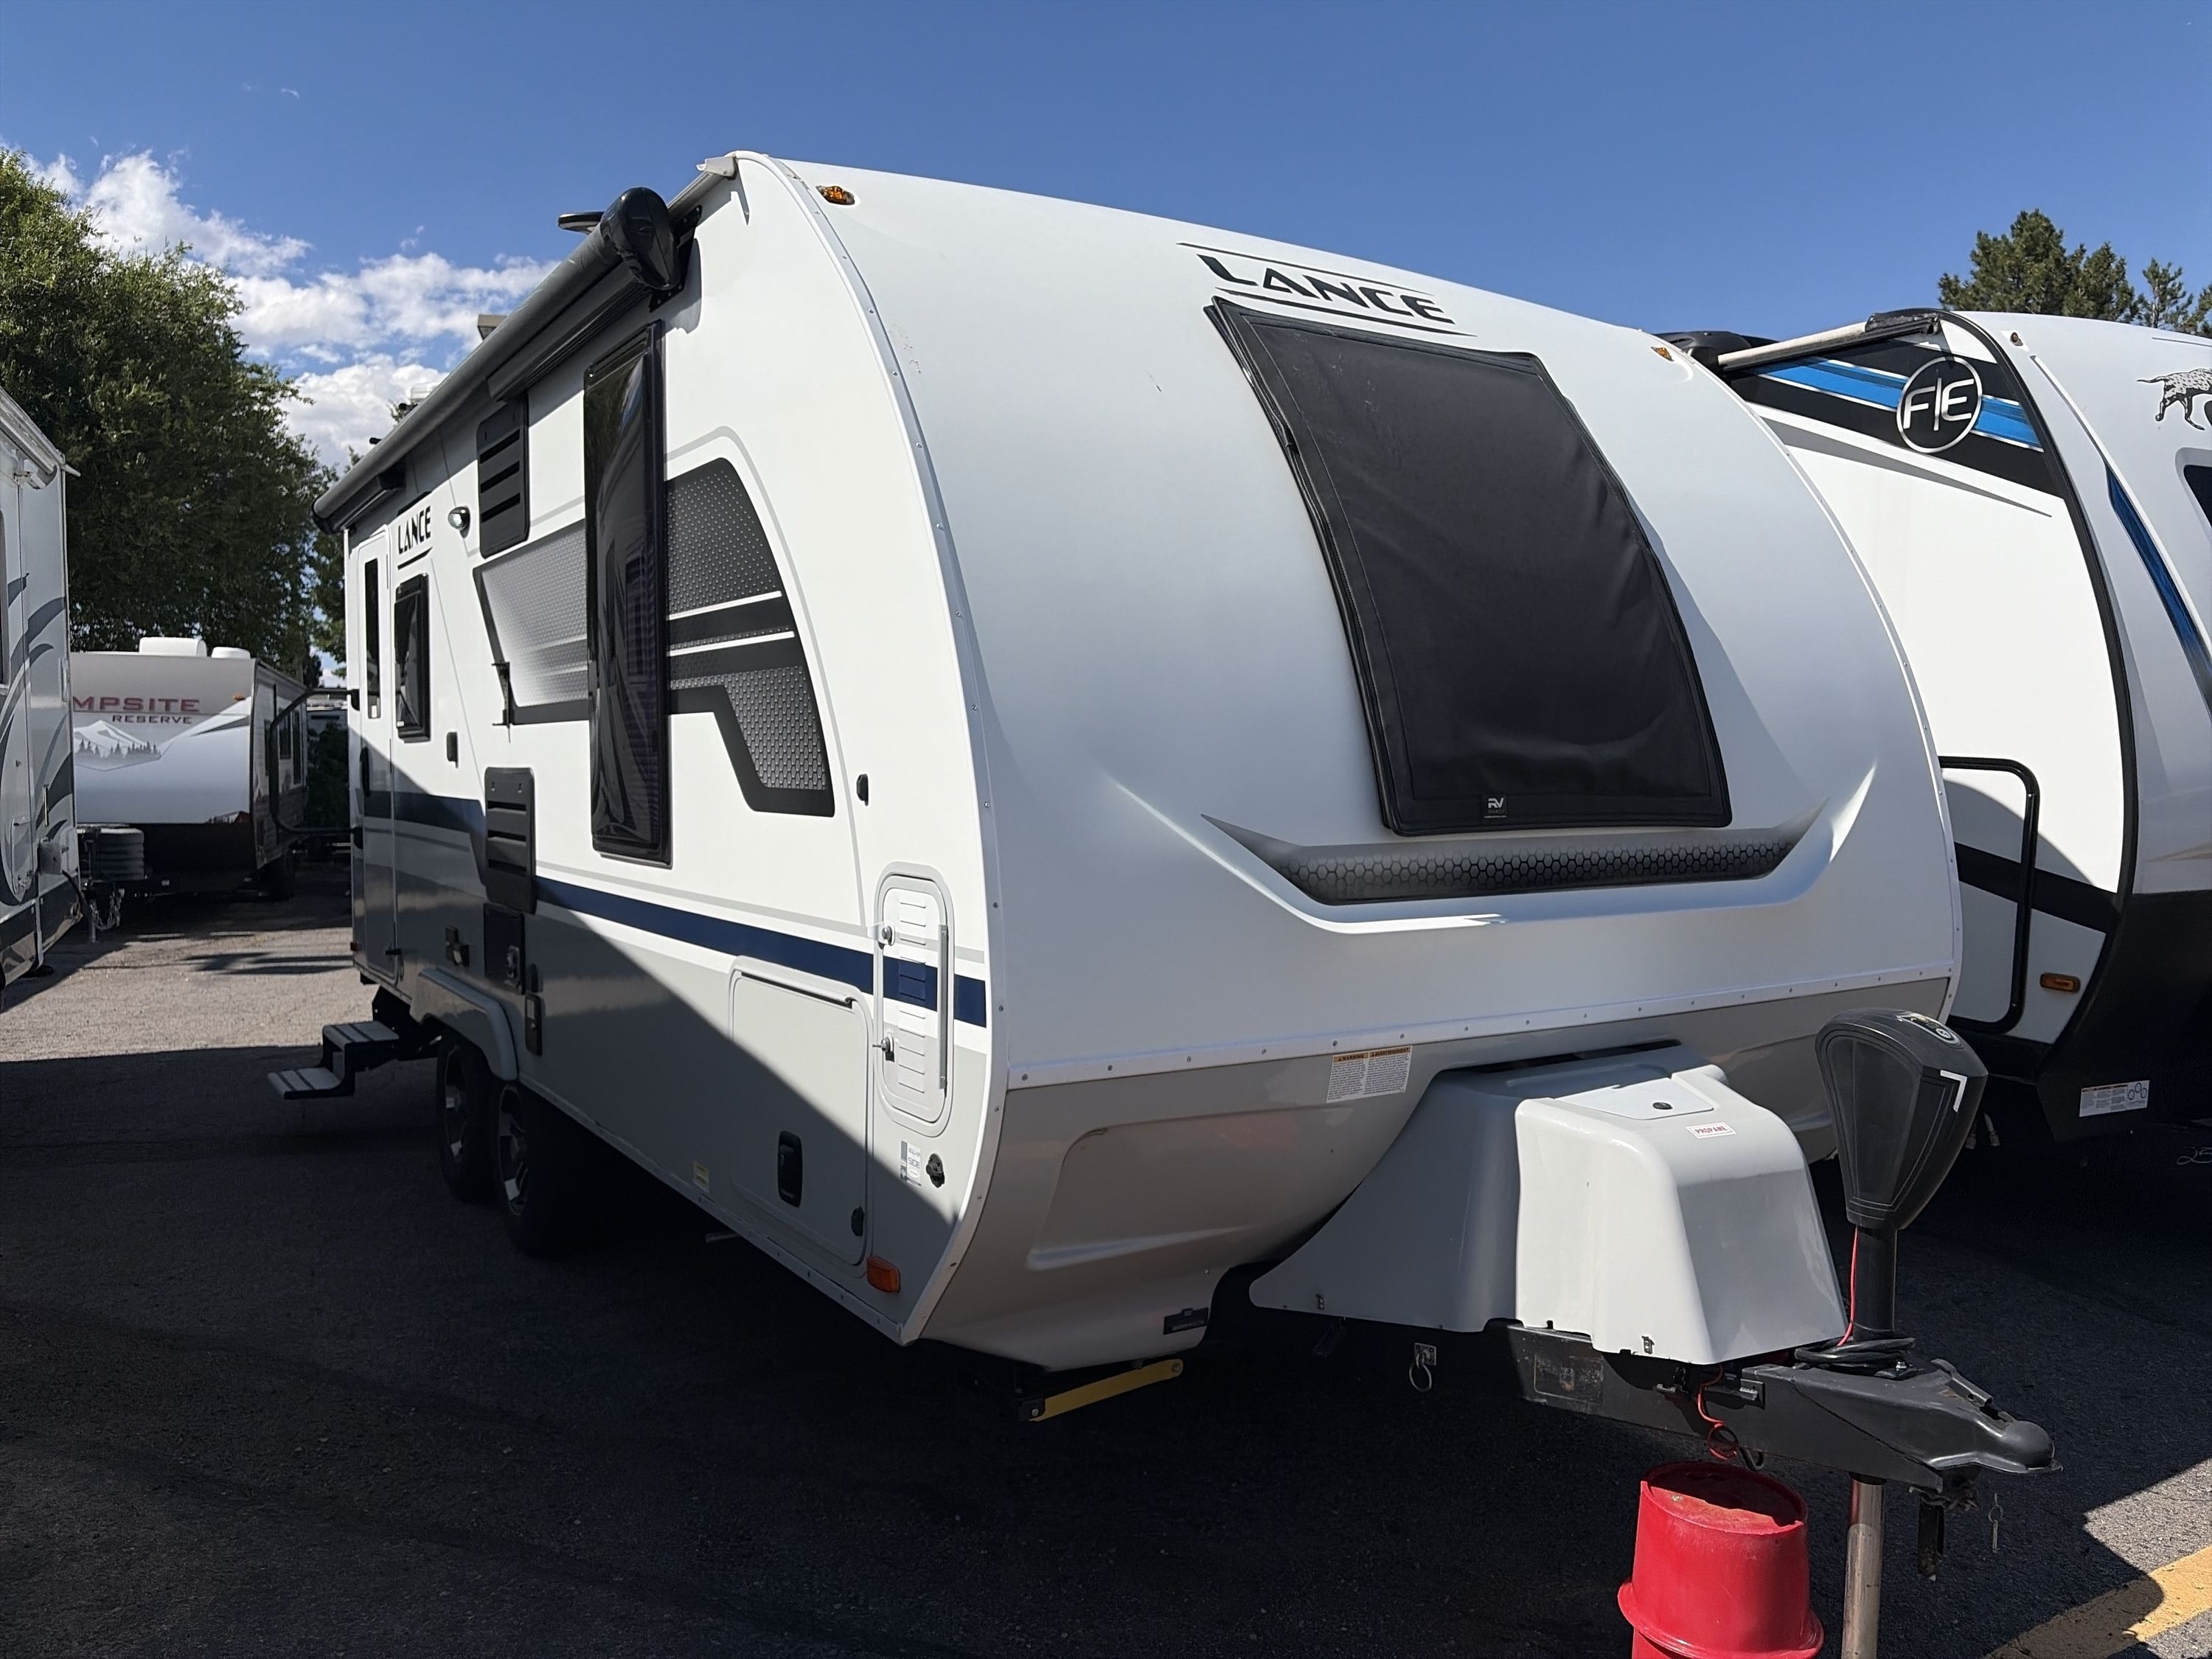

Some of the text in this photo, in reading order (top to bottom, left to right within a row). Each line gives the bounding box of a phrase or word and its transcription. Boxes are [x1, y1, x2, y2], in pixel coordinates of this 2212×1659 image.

[1196, 253, 1456, 325] LANCE
[398, 505, 431, 554] LANCE
[111, 714, 192, 724] RESERVE
[1488, 797, 1504, 808] RV
[1694, 1126, 1728, 1134] PROPANE
